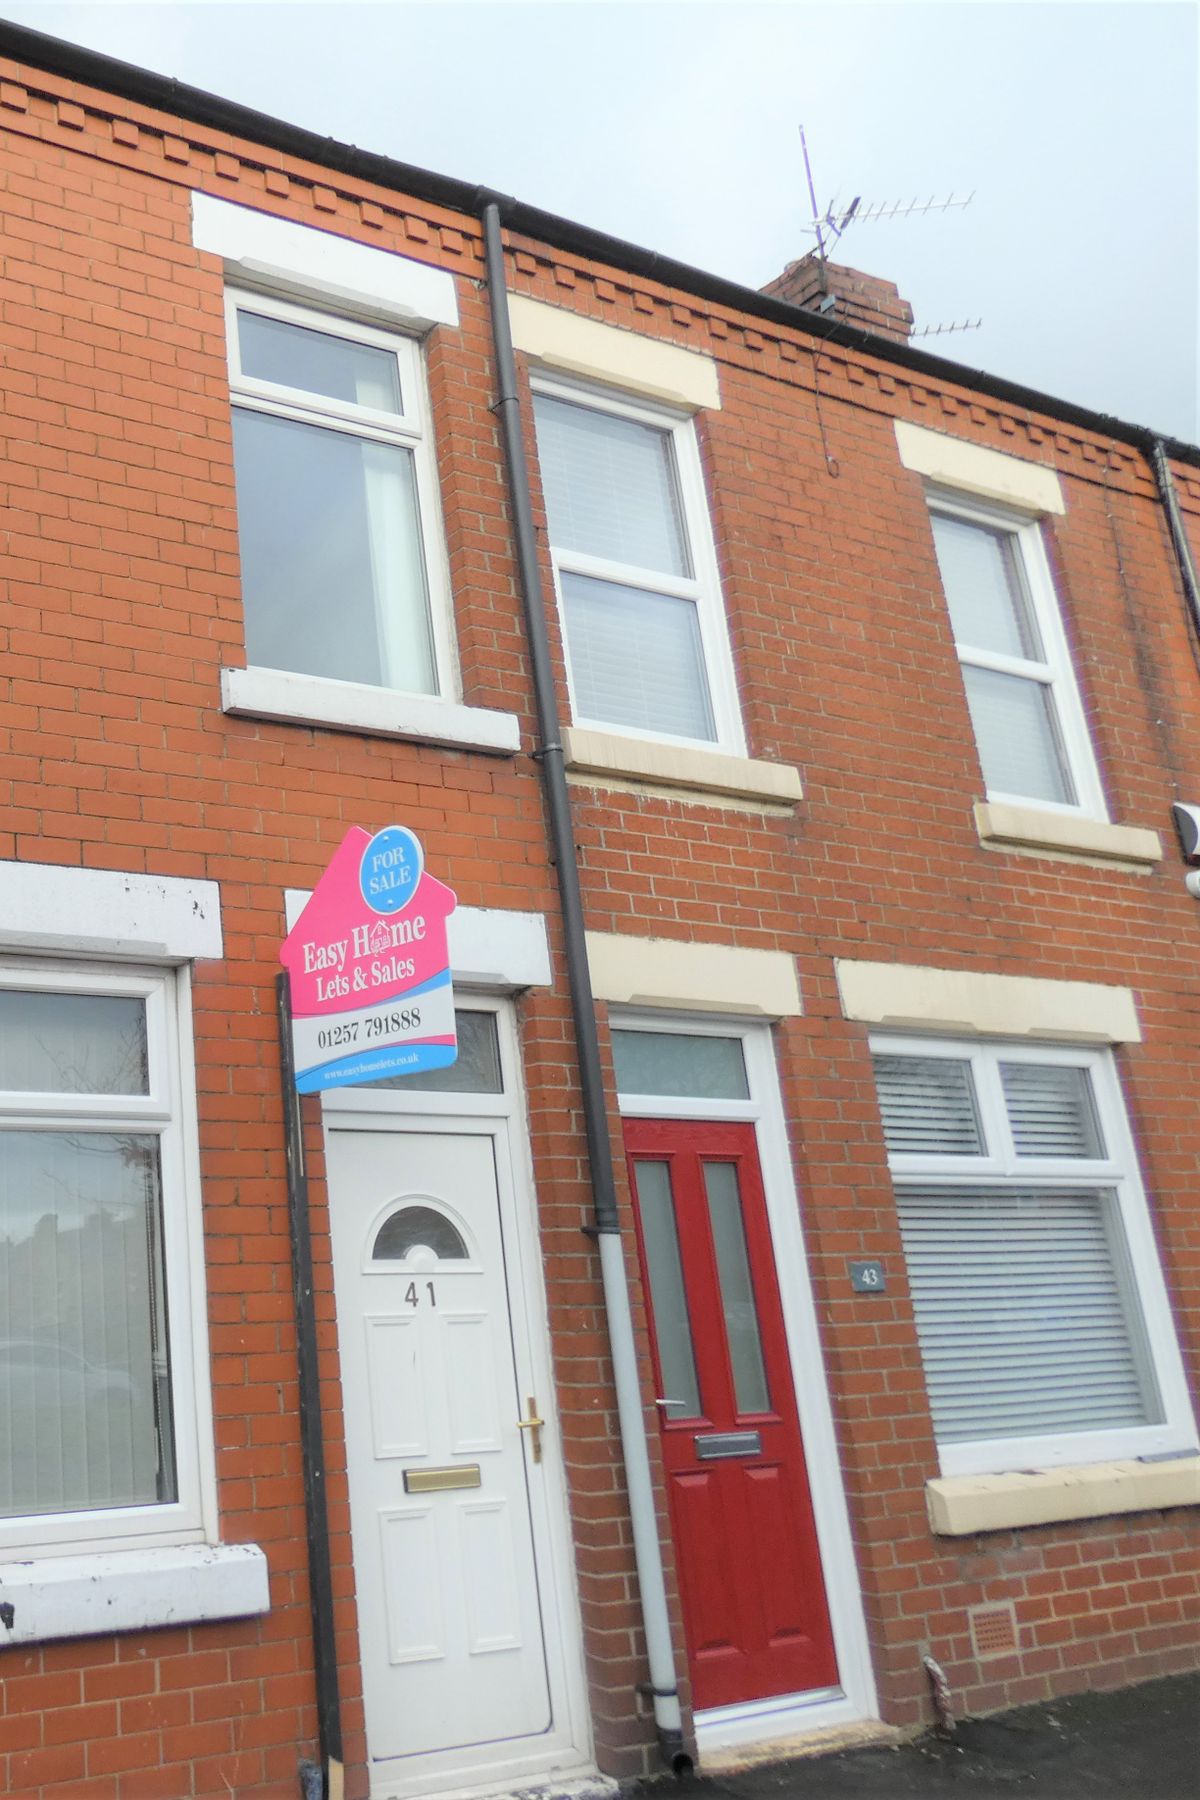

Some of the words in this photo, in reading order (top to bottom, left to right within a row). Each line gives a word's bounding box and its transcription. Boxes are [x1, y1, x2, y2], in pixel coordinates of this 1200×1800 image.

[371, 846, 406, 873] FOR
[369, 864, 412, 895] SALE
[301, 941, 349, 974] Easy
[315, 974, 350, 1002] Lets
[352, 966, 369, 992] &
[371, 956, 416, 986] Sales
[317, 1021, 359, 1049] 01257
[364, 1007, 422, 1038] 791888
[862, 1268, 878, 1285] 43
[404, 1281, 436, 1308] 41
